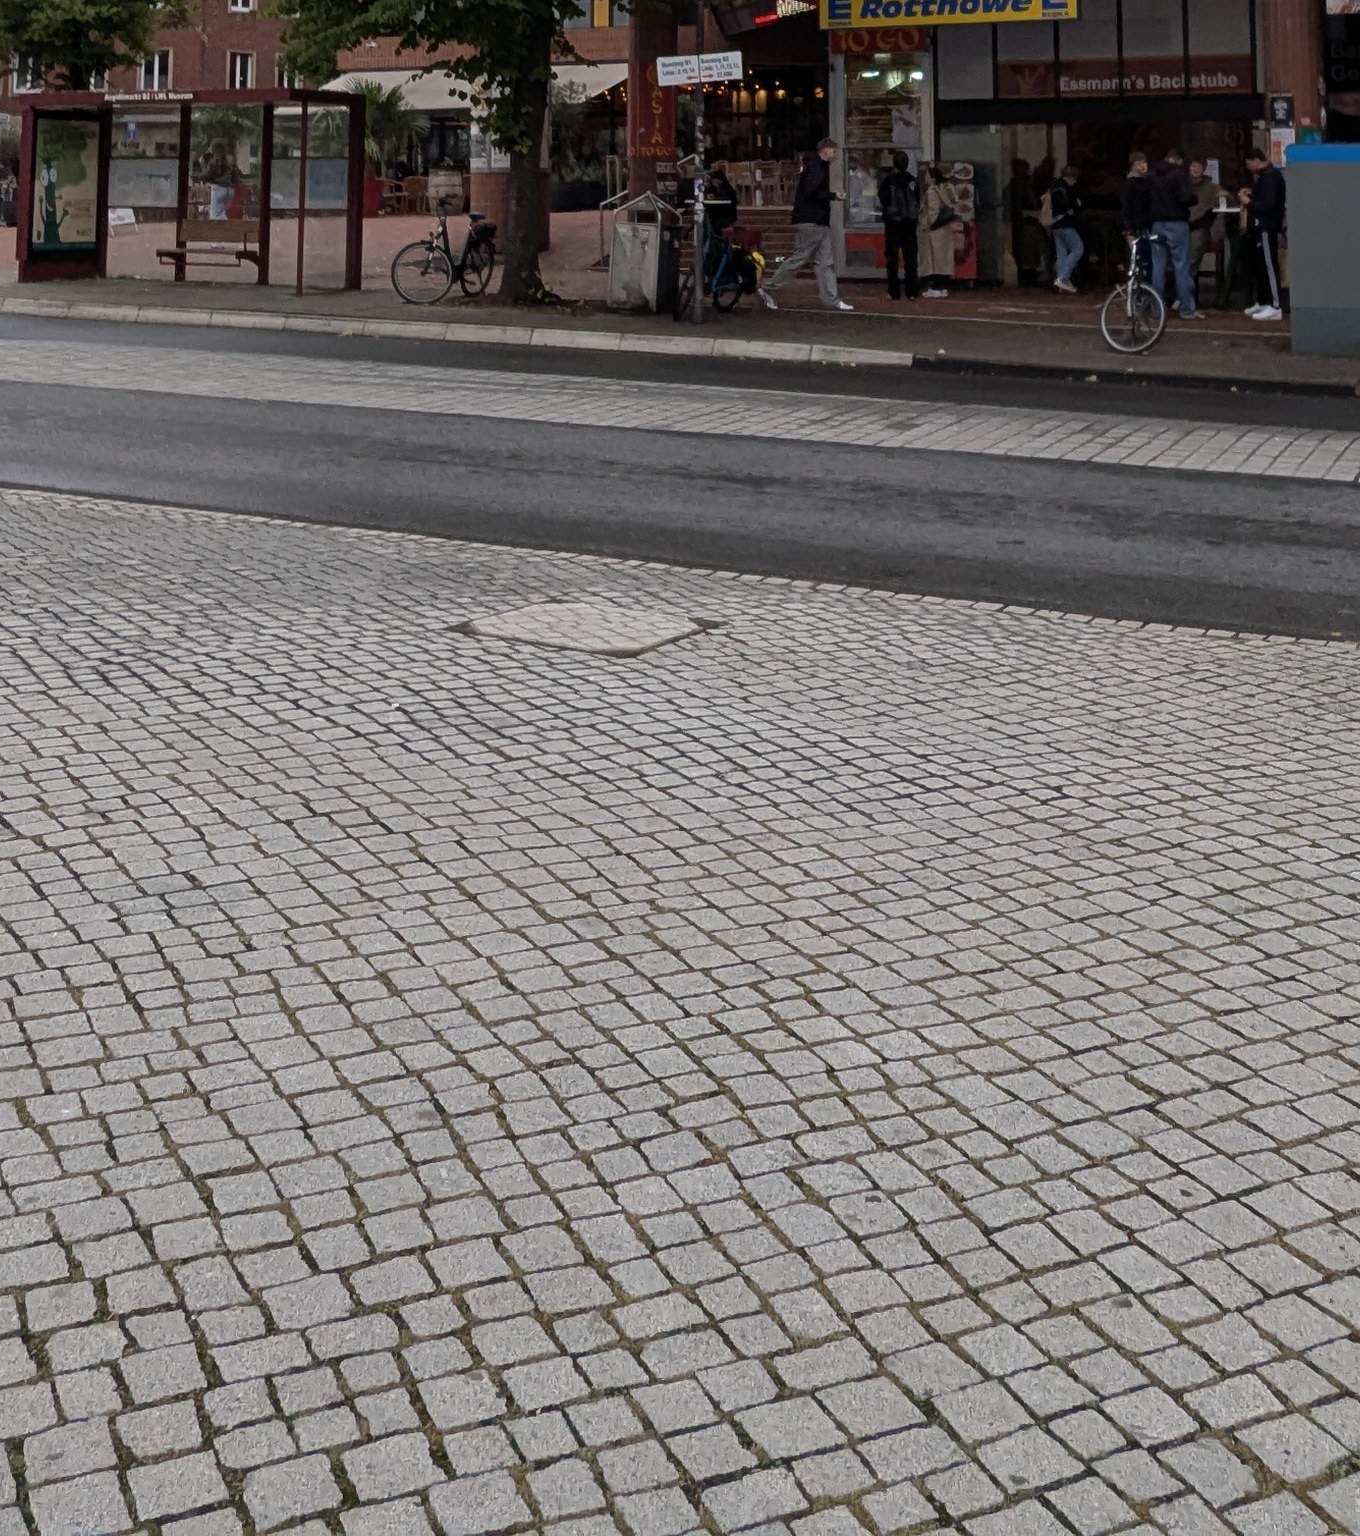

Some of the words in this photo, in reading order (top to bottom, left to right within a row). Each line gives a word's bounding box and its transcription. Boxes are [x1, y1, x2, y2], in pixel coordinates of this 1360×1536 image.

[837, 29, 870, 52] TO
[876, 29, 920, 52] GO
[651, 86, 664, 145] ASIA
